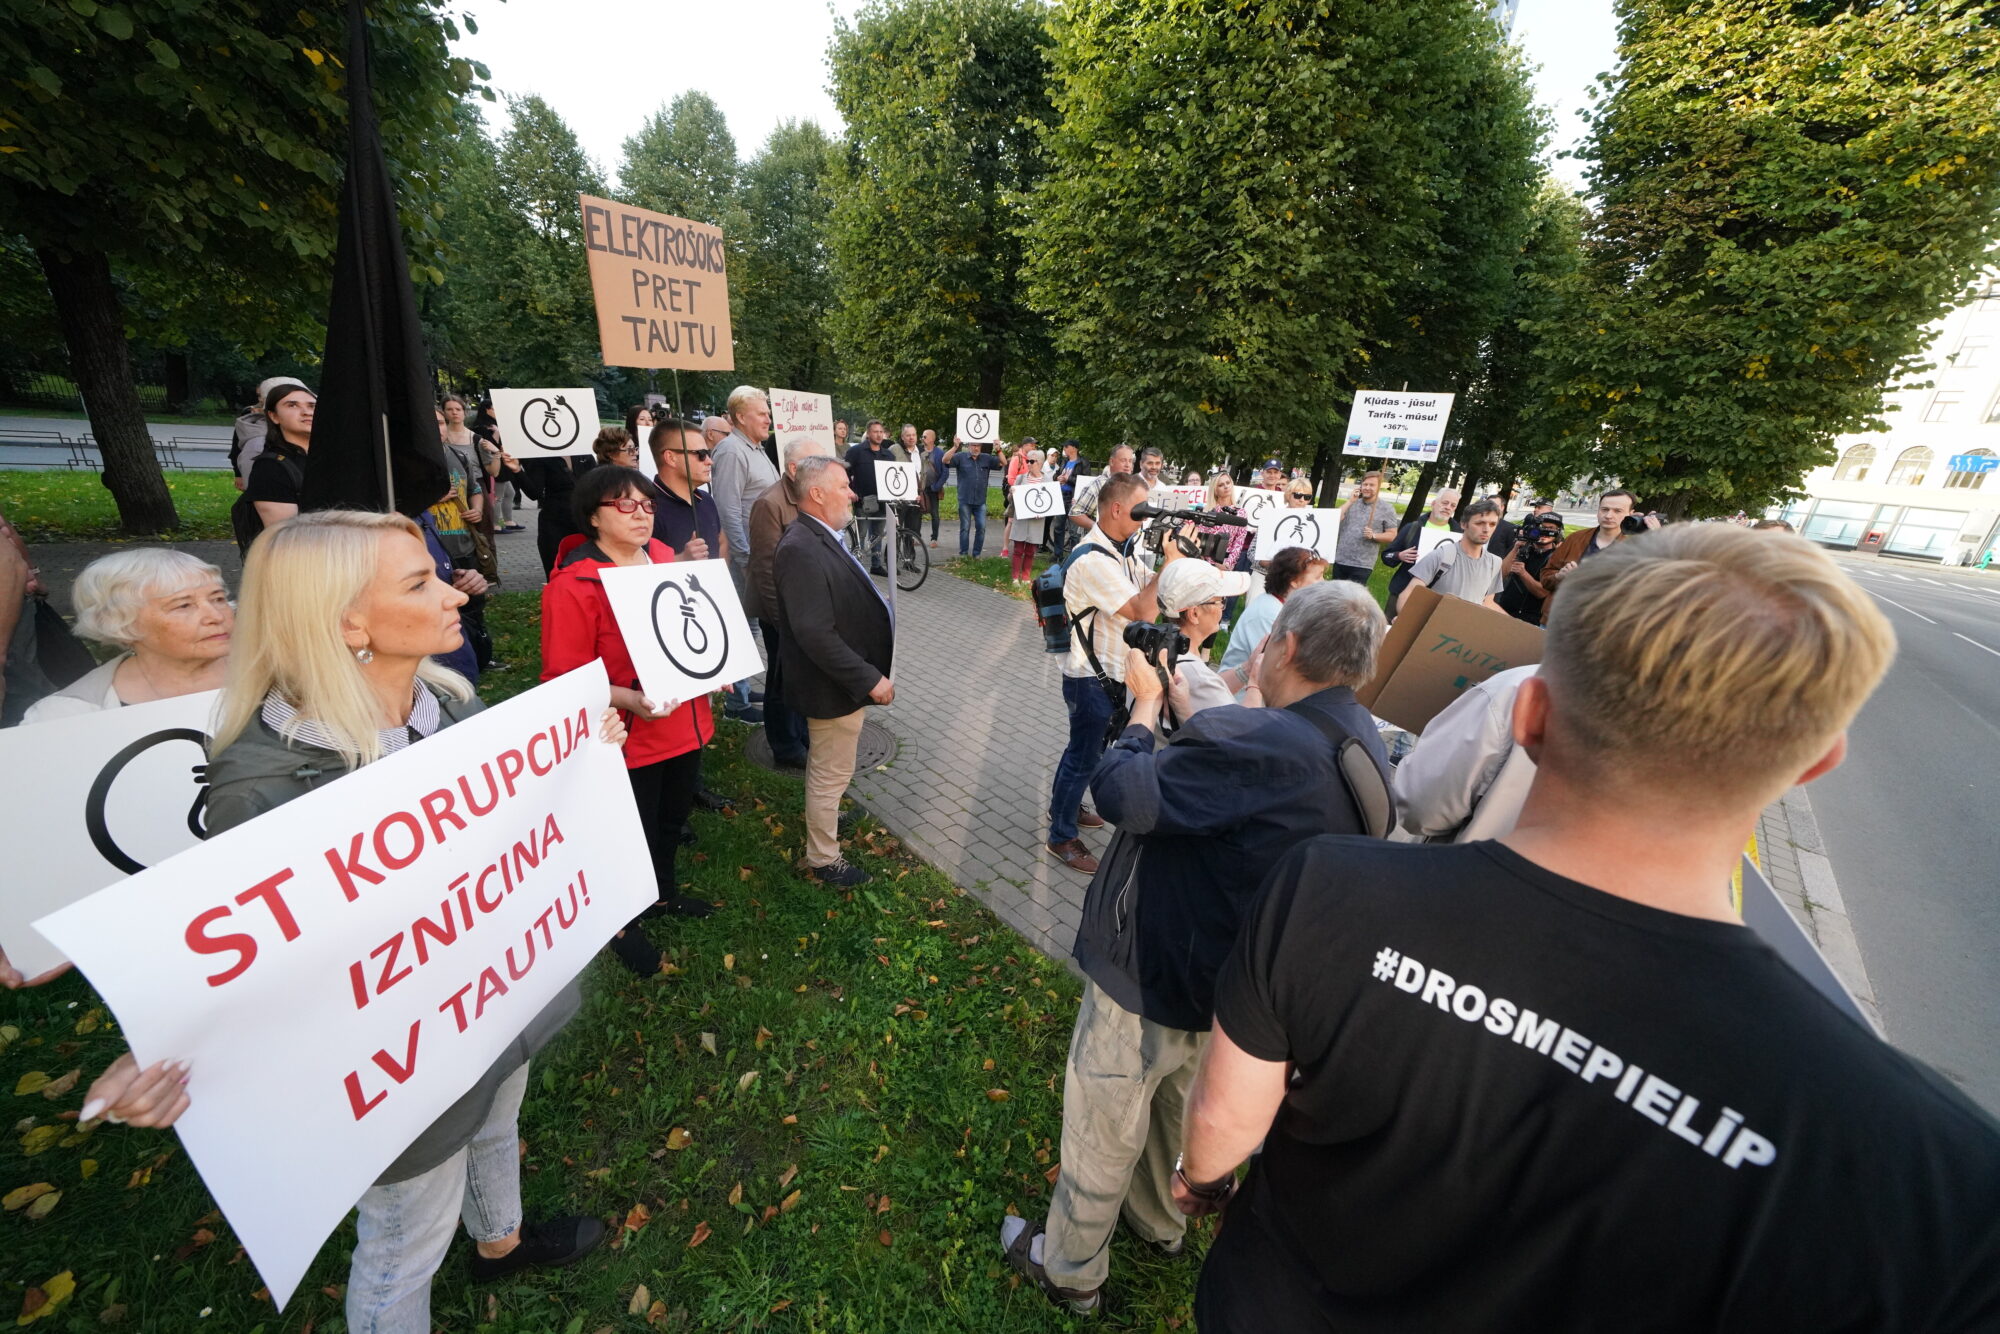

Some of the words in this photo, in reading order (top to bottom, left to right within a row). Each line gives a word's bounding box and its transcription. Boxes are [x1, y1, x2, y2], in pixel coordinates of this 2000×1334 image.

[585, 205, 724, 274] ELEKTROŠOKS
[632, 269, 701, 315] PRET
[621, 315, 716, 358] TAUTU
[1363, 397, 1400, 407] Kļūdas
[1408, 399, 1436, 408] jūsu!
[1367, 410, 1396, 420] Tarifs
[1405, 412, 1438, 422] mūsu!
[1383, 424, 1409, 432] +367%
[185, 867, 301, 988] ST
[324, 707, 591, 903] KORUPCIJA
[349, 812, 564, 1010] IZNĪCINA
[343, 1019, 421, 1121] LV
[439, 870, 591, 1034] TAUTU!
[1372, 946, 1777, 1169] #DROSMEPIELĪP
